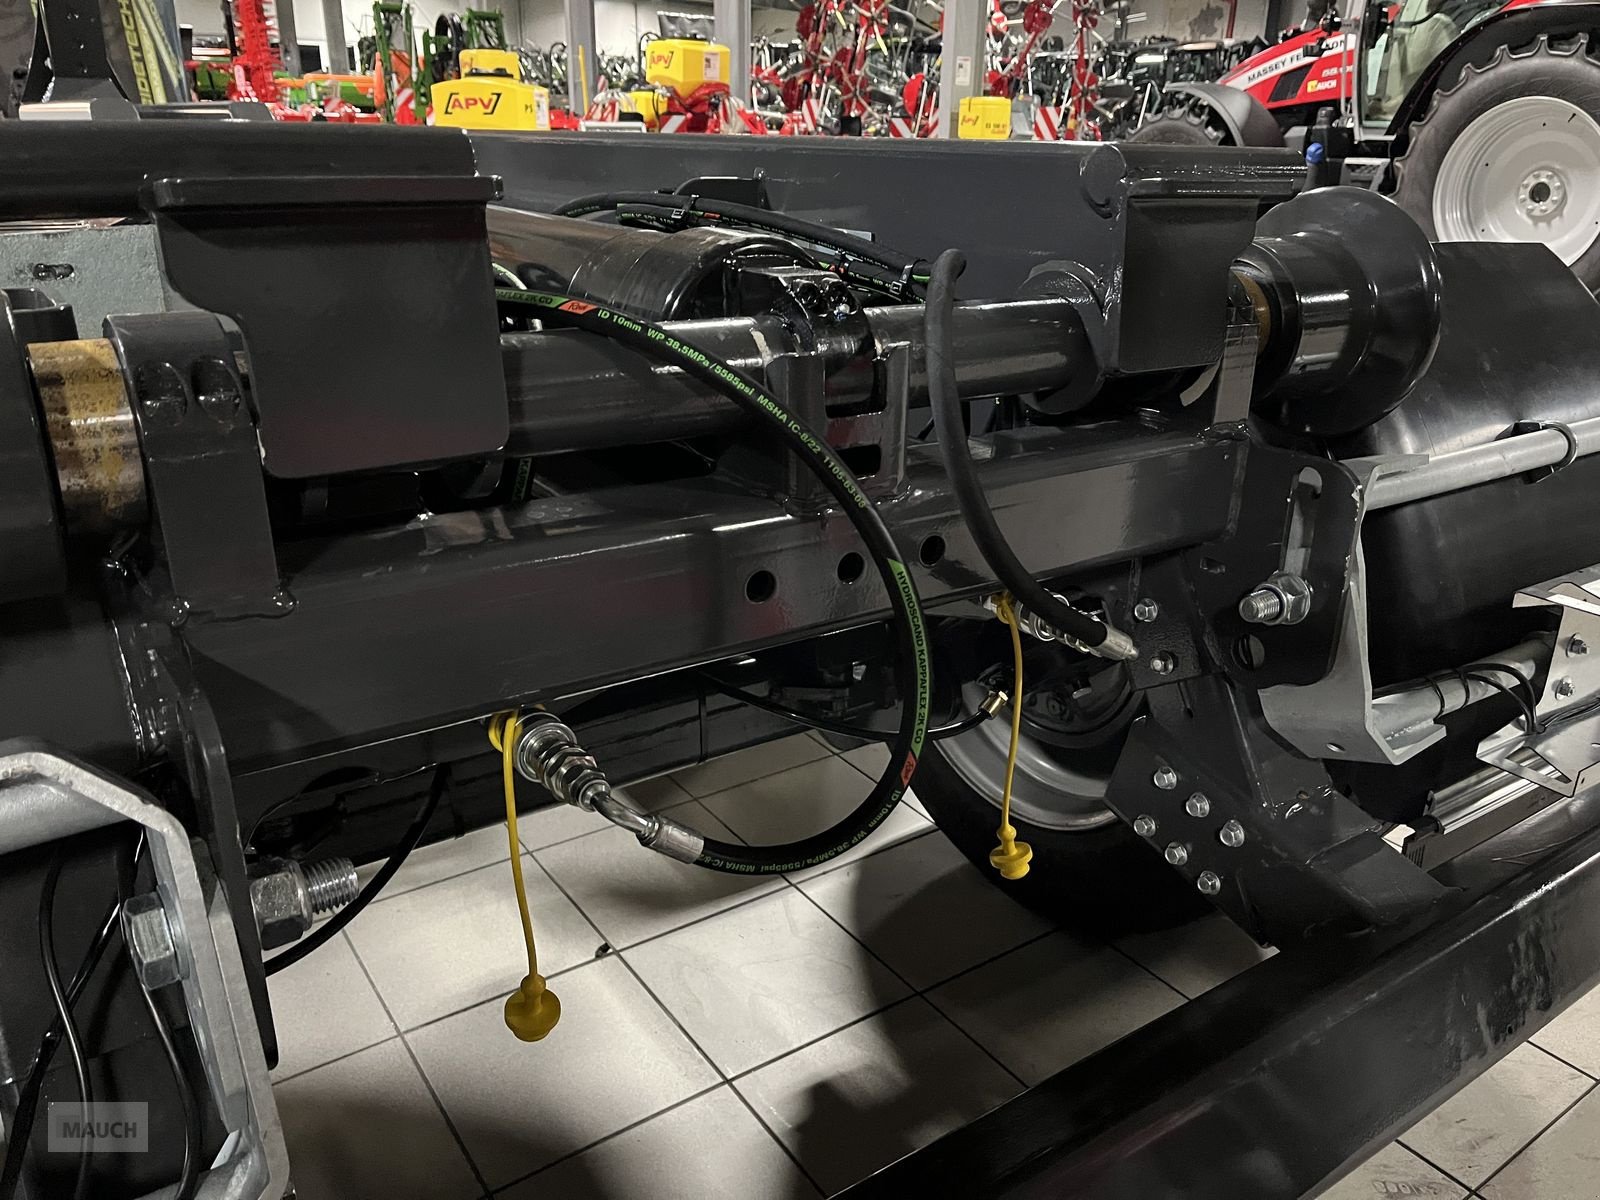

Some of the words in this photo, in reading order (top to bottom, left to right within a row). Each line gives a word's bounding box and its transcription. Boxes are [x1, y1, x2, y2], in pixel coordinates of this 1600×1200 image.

[1247, 57, 1286, 83] MASSEY
[538, 294, 553, 305] CO
[597, 309, 610, 320] ID
[612, 314, 642, 333] 10mm
[647, 327, 665, 341] WP
[757, 394, 788, 424] MSHA
[896, 570, 924, 647] HYDROSCAND
[917, 649, 929, 710] KAPPAFLEX
[917, 712, 926, 726] 2K
[914, 728, 924, 744] CO
[891, 790, 901, 802] ID
[868, 803, 893, 828] 10mm
[851, 829, 868, 845] WP
[725, 860, 756, 873] MSHA
